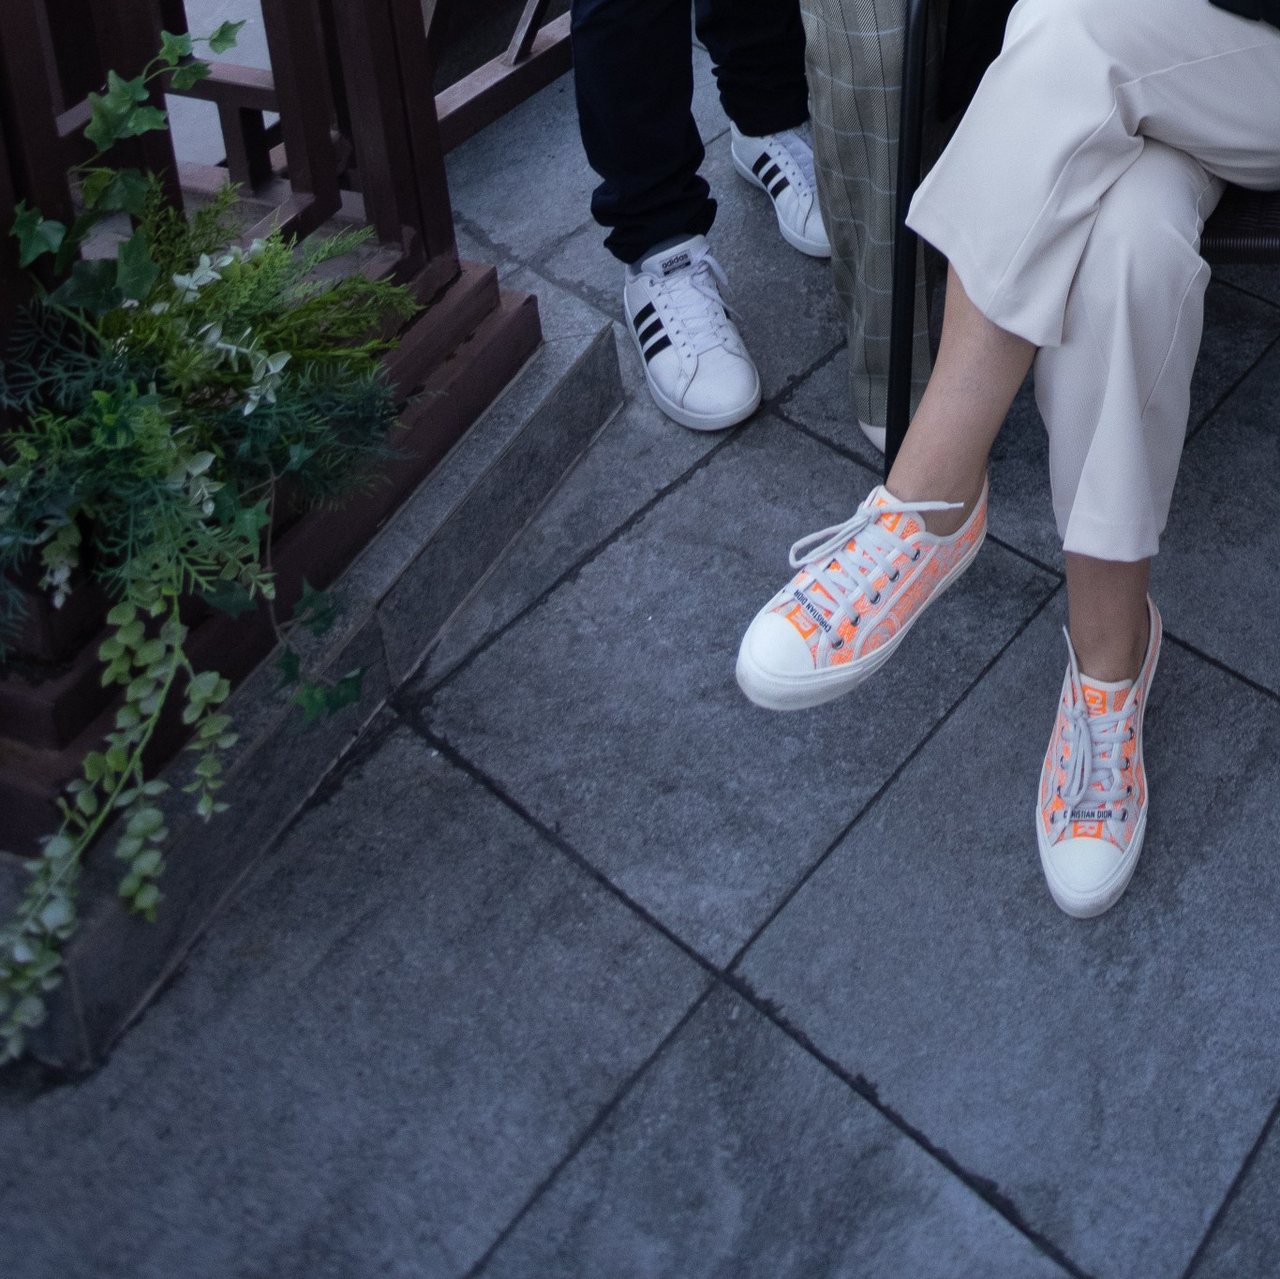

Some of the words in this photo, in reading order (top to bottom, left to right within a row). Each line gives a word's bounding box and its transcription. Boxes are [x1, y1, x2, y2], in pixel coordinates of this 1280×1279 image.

[661, 253, 689, 269] adidas
[793, 589, 808, 606] DIOR
[805, 602, 832, 633] CHRISTIAN
[1063, 810, 1095, 819] CRISTIAN
